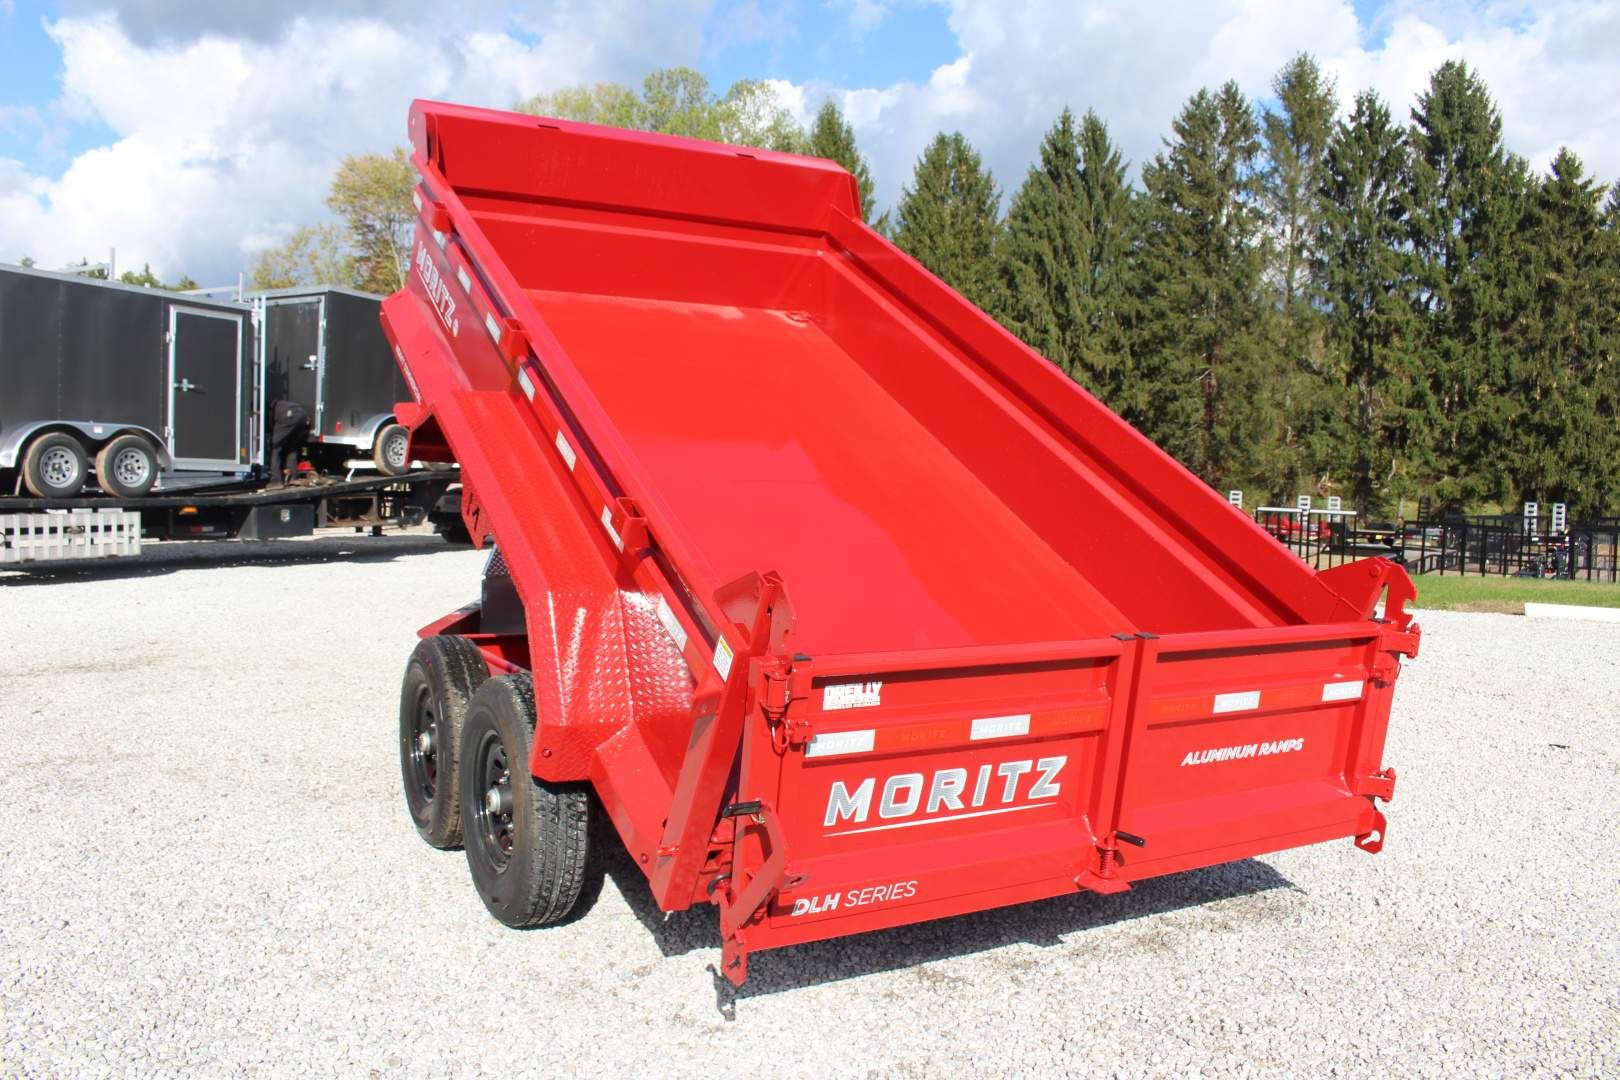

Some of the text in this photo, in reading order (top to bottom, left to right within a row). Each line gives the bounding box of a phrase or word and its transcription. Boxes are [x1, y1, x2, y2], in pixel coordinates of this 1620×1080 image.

[416, 240, 456, 328] MORITZ
[1160, 703, 1197, 714] MORITZ
[1220, 697, 1254, 708] MORITZ
[1328, 686, 1358, 696] MORITZ
[815, 714, 1092, 750] MORITZ MORITZ MORITZ MORITZ
[1181, 738, 1305, 766] ALUMINUM RAMPS
[823, 755, 1068, 827] MORITZ
[791, 880, 918, 917] DLH SERIES
